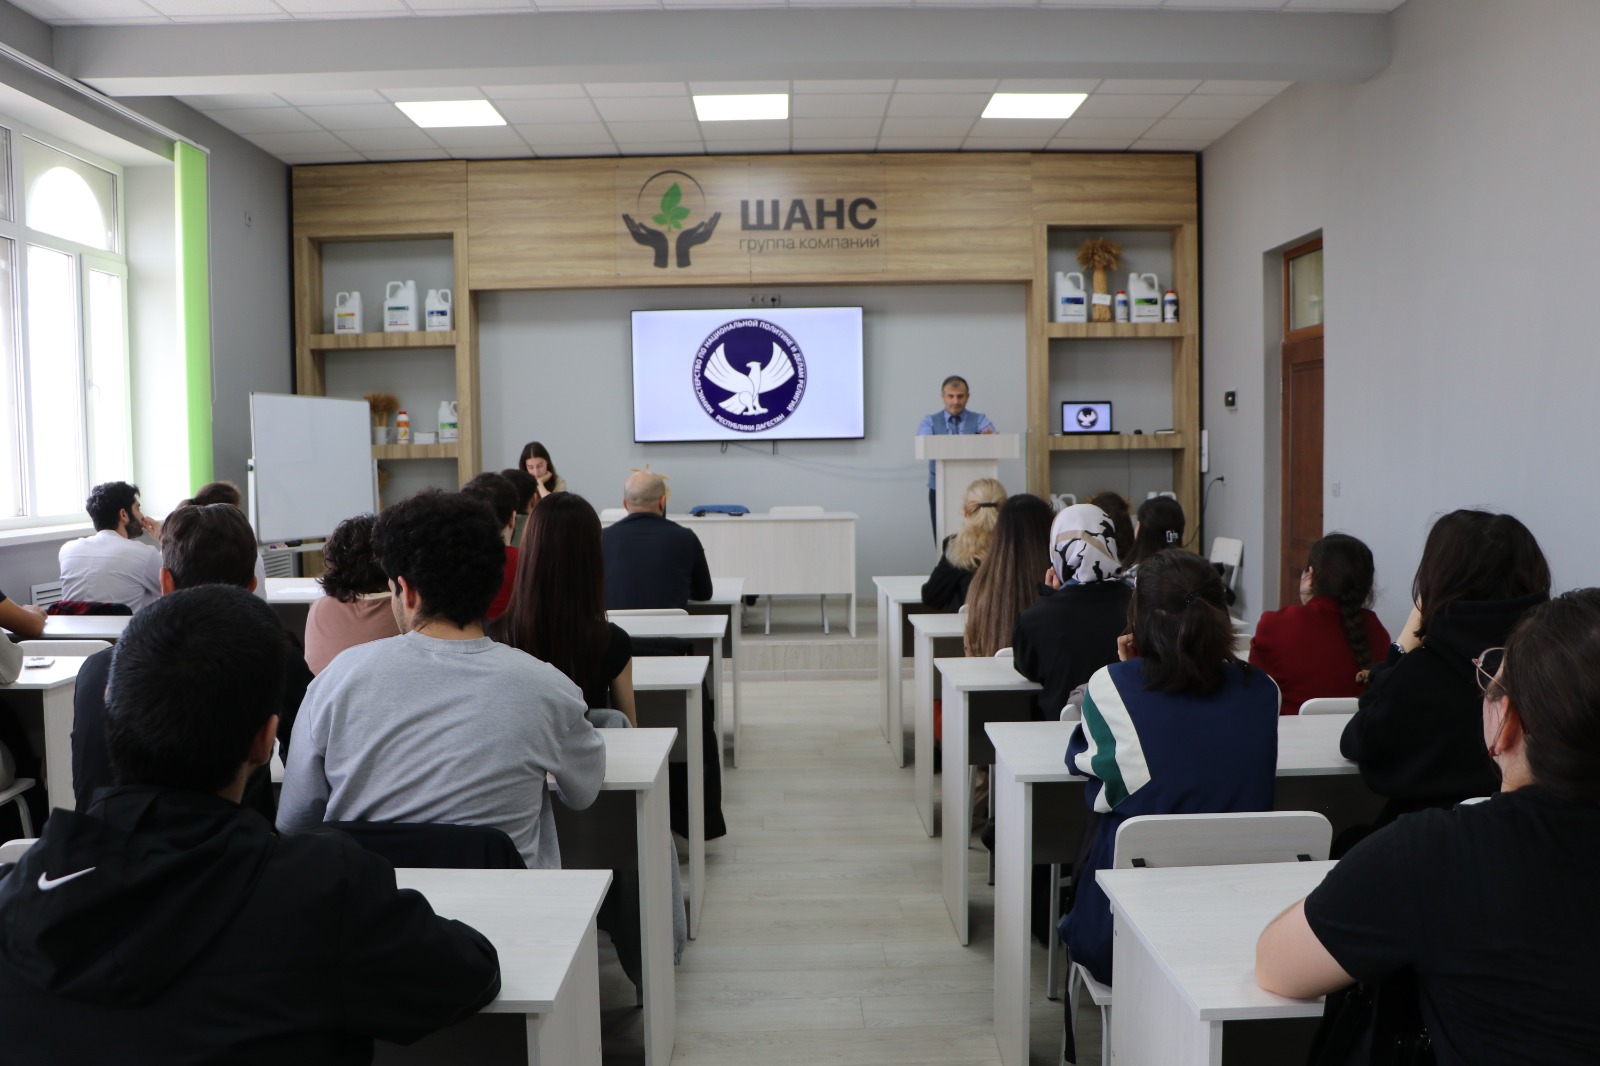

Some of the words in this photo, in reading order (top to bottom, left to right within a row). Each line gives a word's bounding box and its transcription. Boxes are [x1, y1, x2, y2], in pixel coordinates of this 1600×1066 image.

[740, 197, 878, 231] ШАНС
[739, 237, 795, 254] группа
[799, 234, 880, 250] компаний
[704, 319, 759, 349] НАЦИОНАЛЬНОЙ
[759, 321, 794, 347] ПОЛИТИКЕ
[698, 347, 707, 359] ПО
[790, 345, 798, 353] И
[792, 352, 805, 378] ДЕЛАМ
[694, 358, 715, 414] МИНИСТЕРСТВО
[715, 414, 755, 431] РЕСПУБЛИКИ
[755, 413, 785, 431] ДАГЕСТАН
